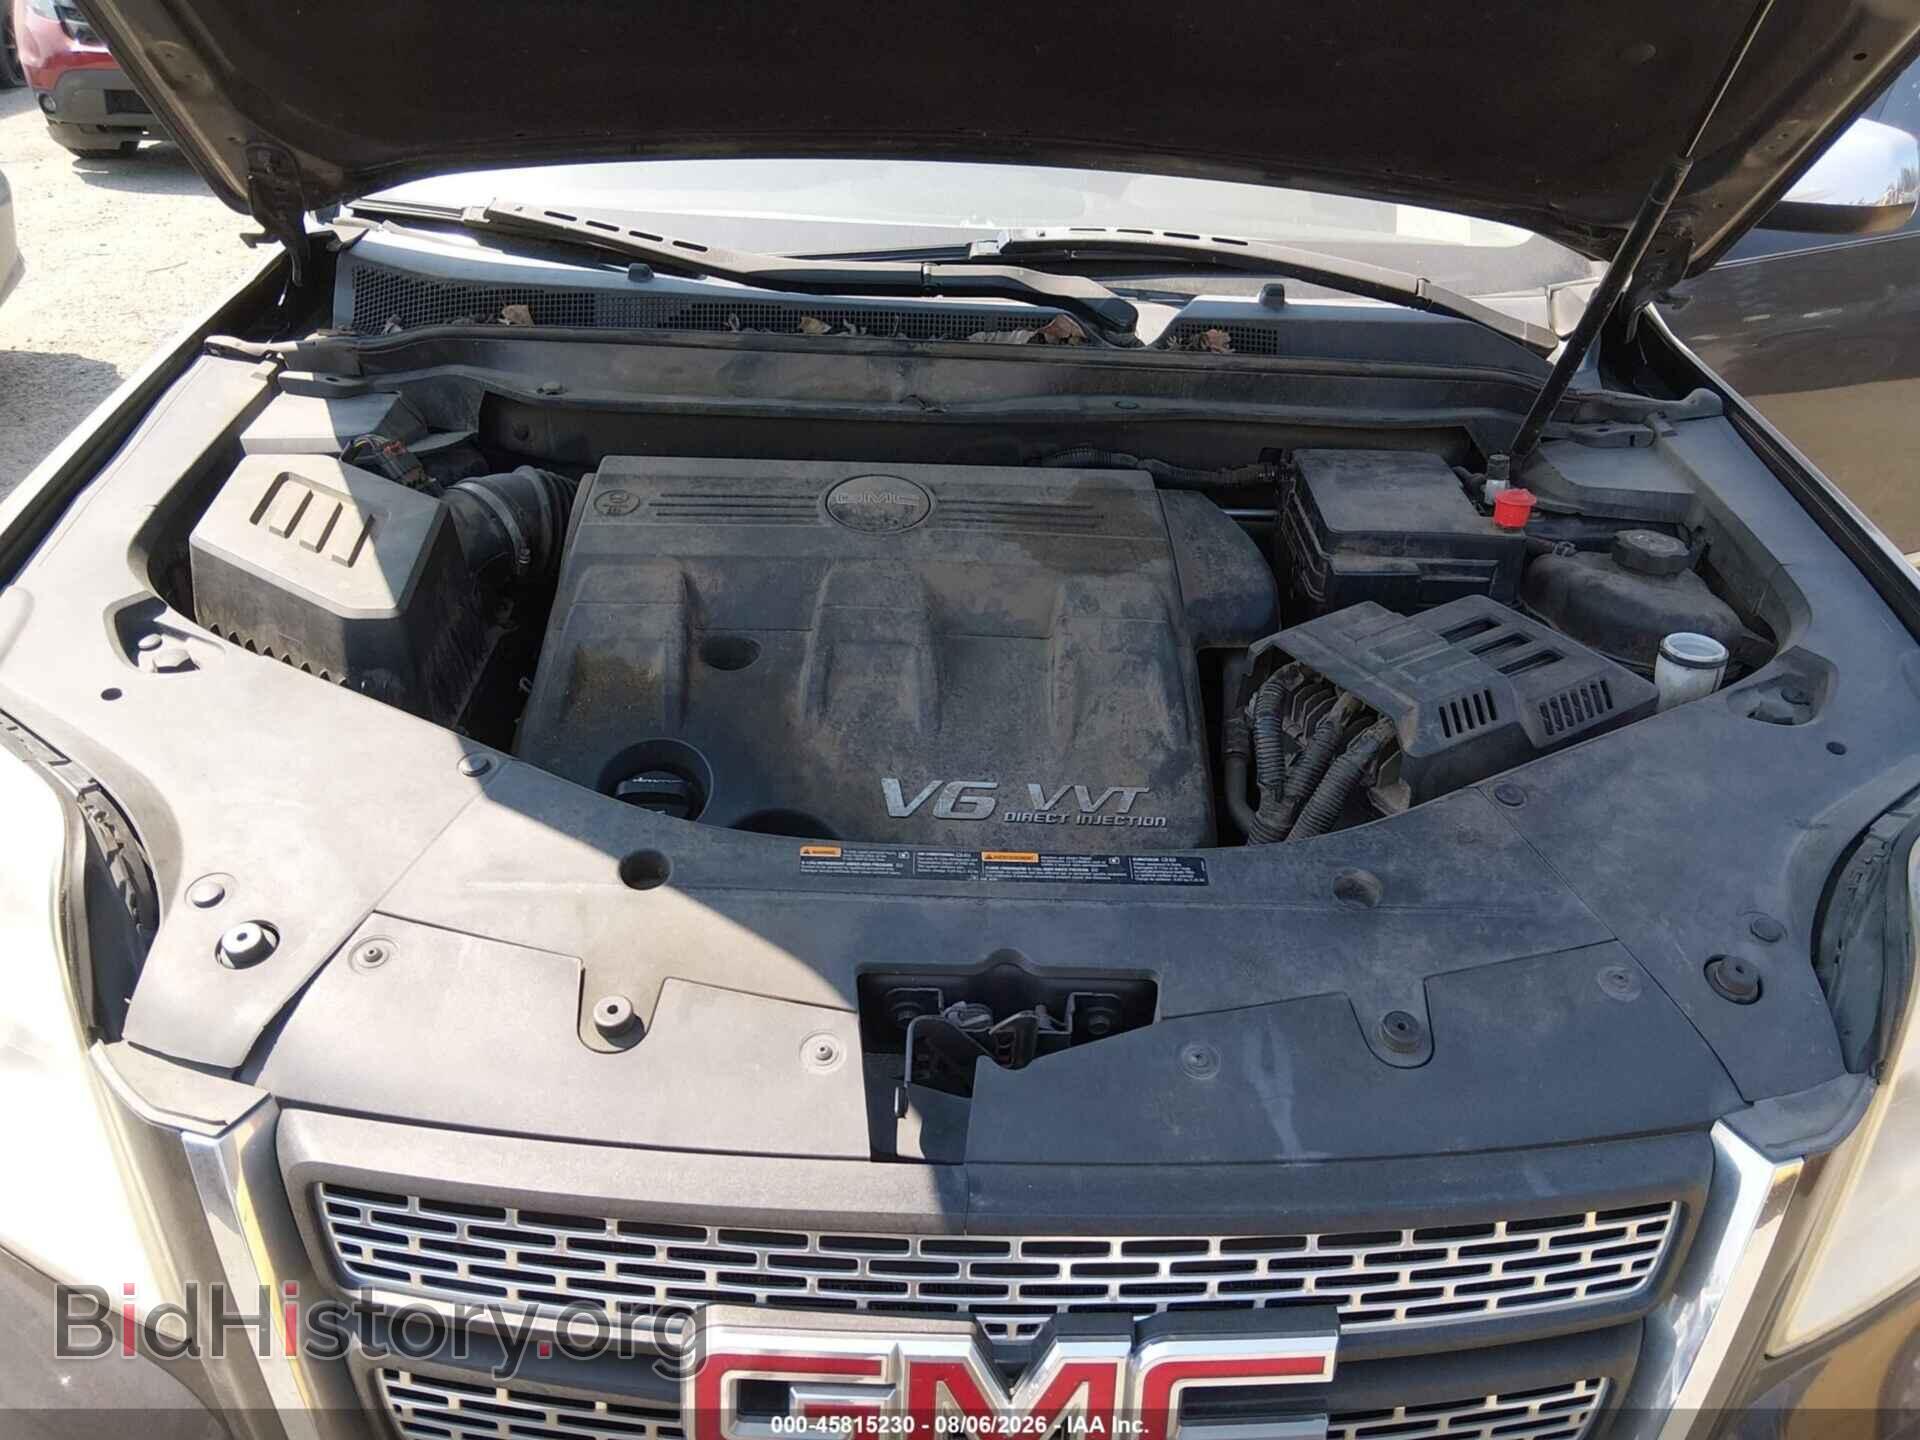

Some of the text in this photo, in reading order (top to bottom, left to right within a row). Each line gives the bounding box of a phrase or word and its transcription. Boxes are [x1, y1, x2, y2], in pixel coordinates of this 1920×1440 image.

[881, 778, 1150, 820] V6 VVT
[1003, 811, 1070, 825] DIRECT
[695, 1330, 1338, 1440] GMC
